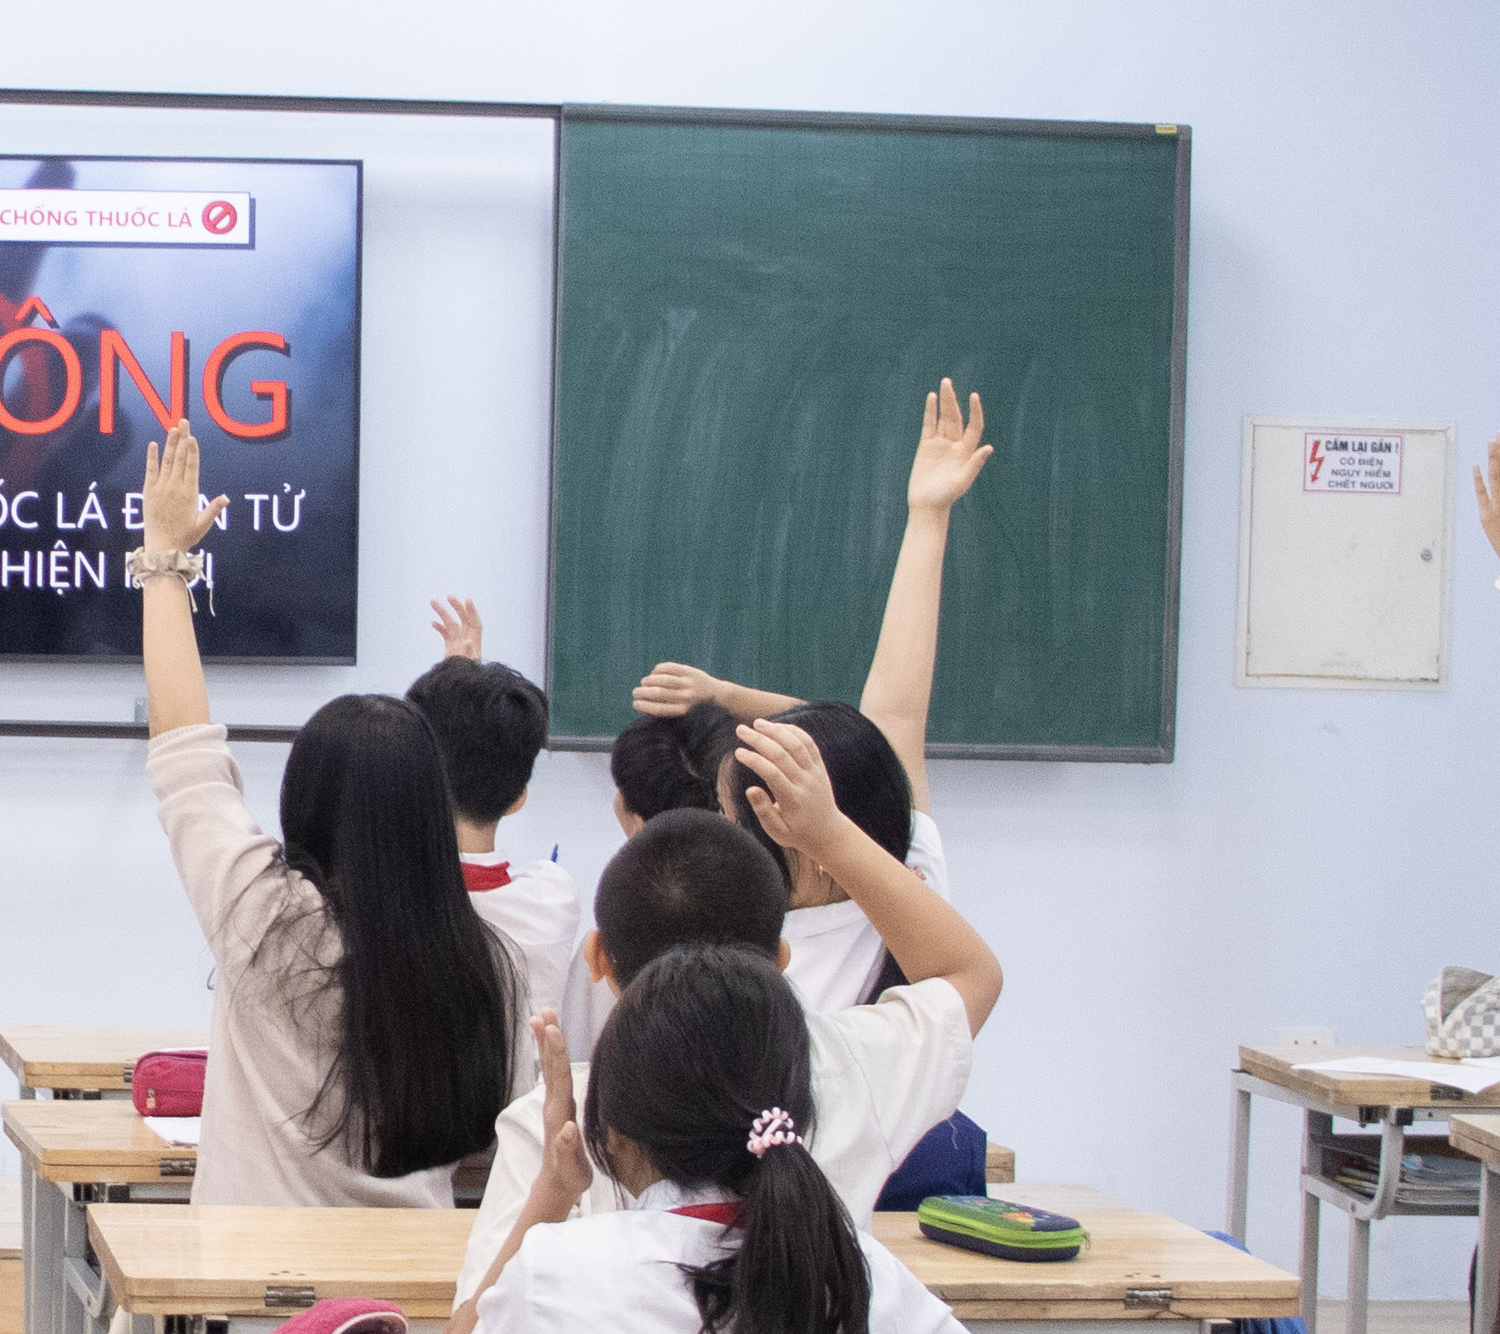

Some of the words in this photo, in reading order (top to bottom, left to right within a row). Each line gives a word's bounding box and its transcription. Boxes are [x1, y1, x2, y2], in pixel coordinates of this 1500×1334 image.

[0, 204, 78, 226] CHỐNG
[86, 206, 160, 228] THUỐC
[168, 207, 192, 228] LÁ
[57, 482, 108, 529] LÁ
[244, 483, 306, 532] TỬ
